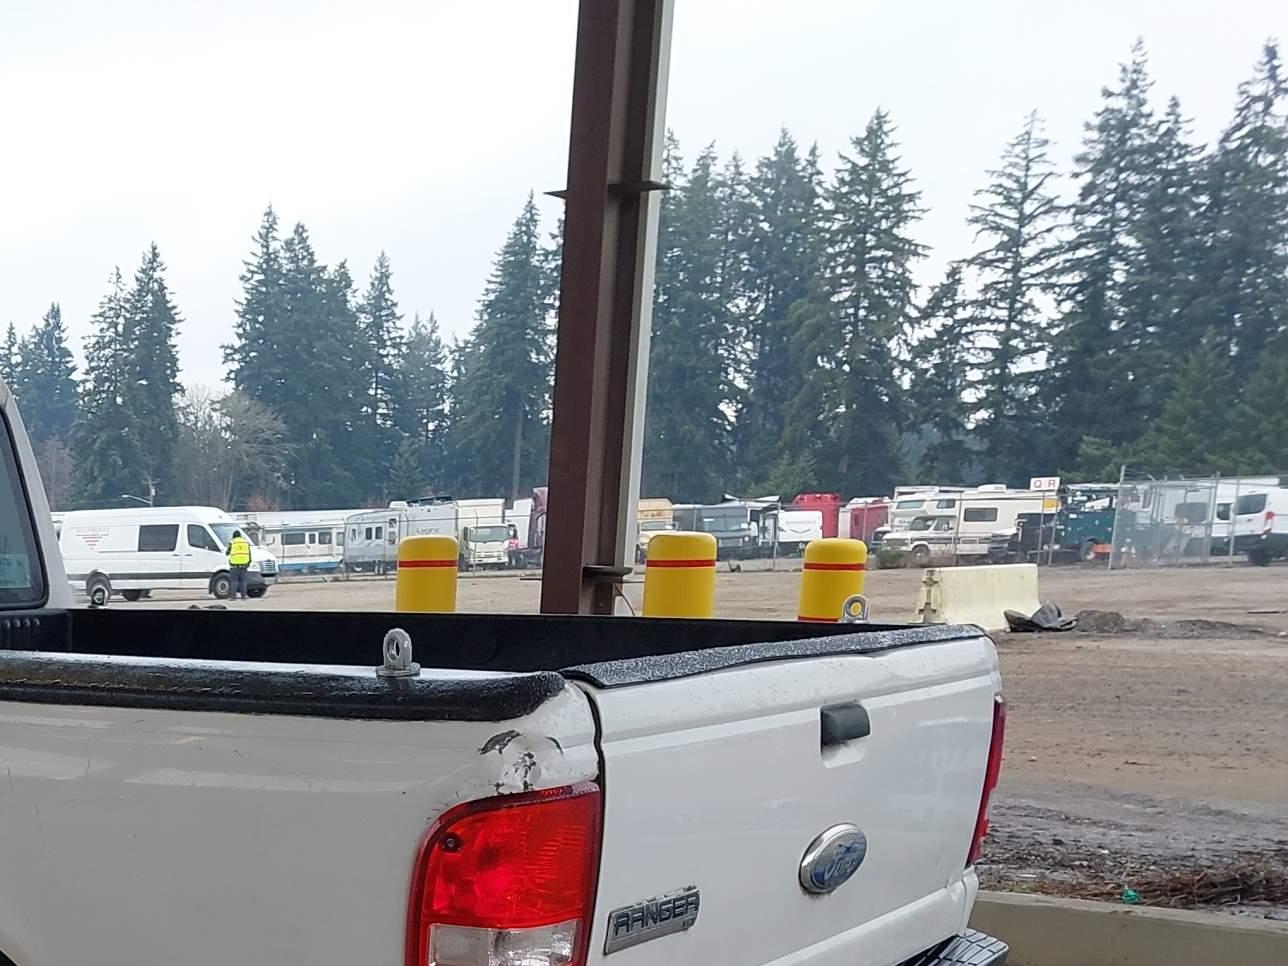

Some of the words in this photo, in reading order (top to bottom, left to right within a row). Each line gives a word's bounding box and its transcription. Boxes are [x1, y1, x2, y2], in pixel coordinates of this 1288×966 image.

[1033, 479, 1042, 488] Q
[1048, 479, 1056, 488] R
[613, 892, 700, 937] RANGER
